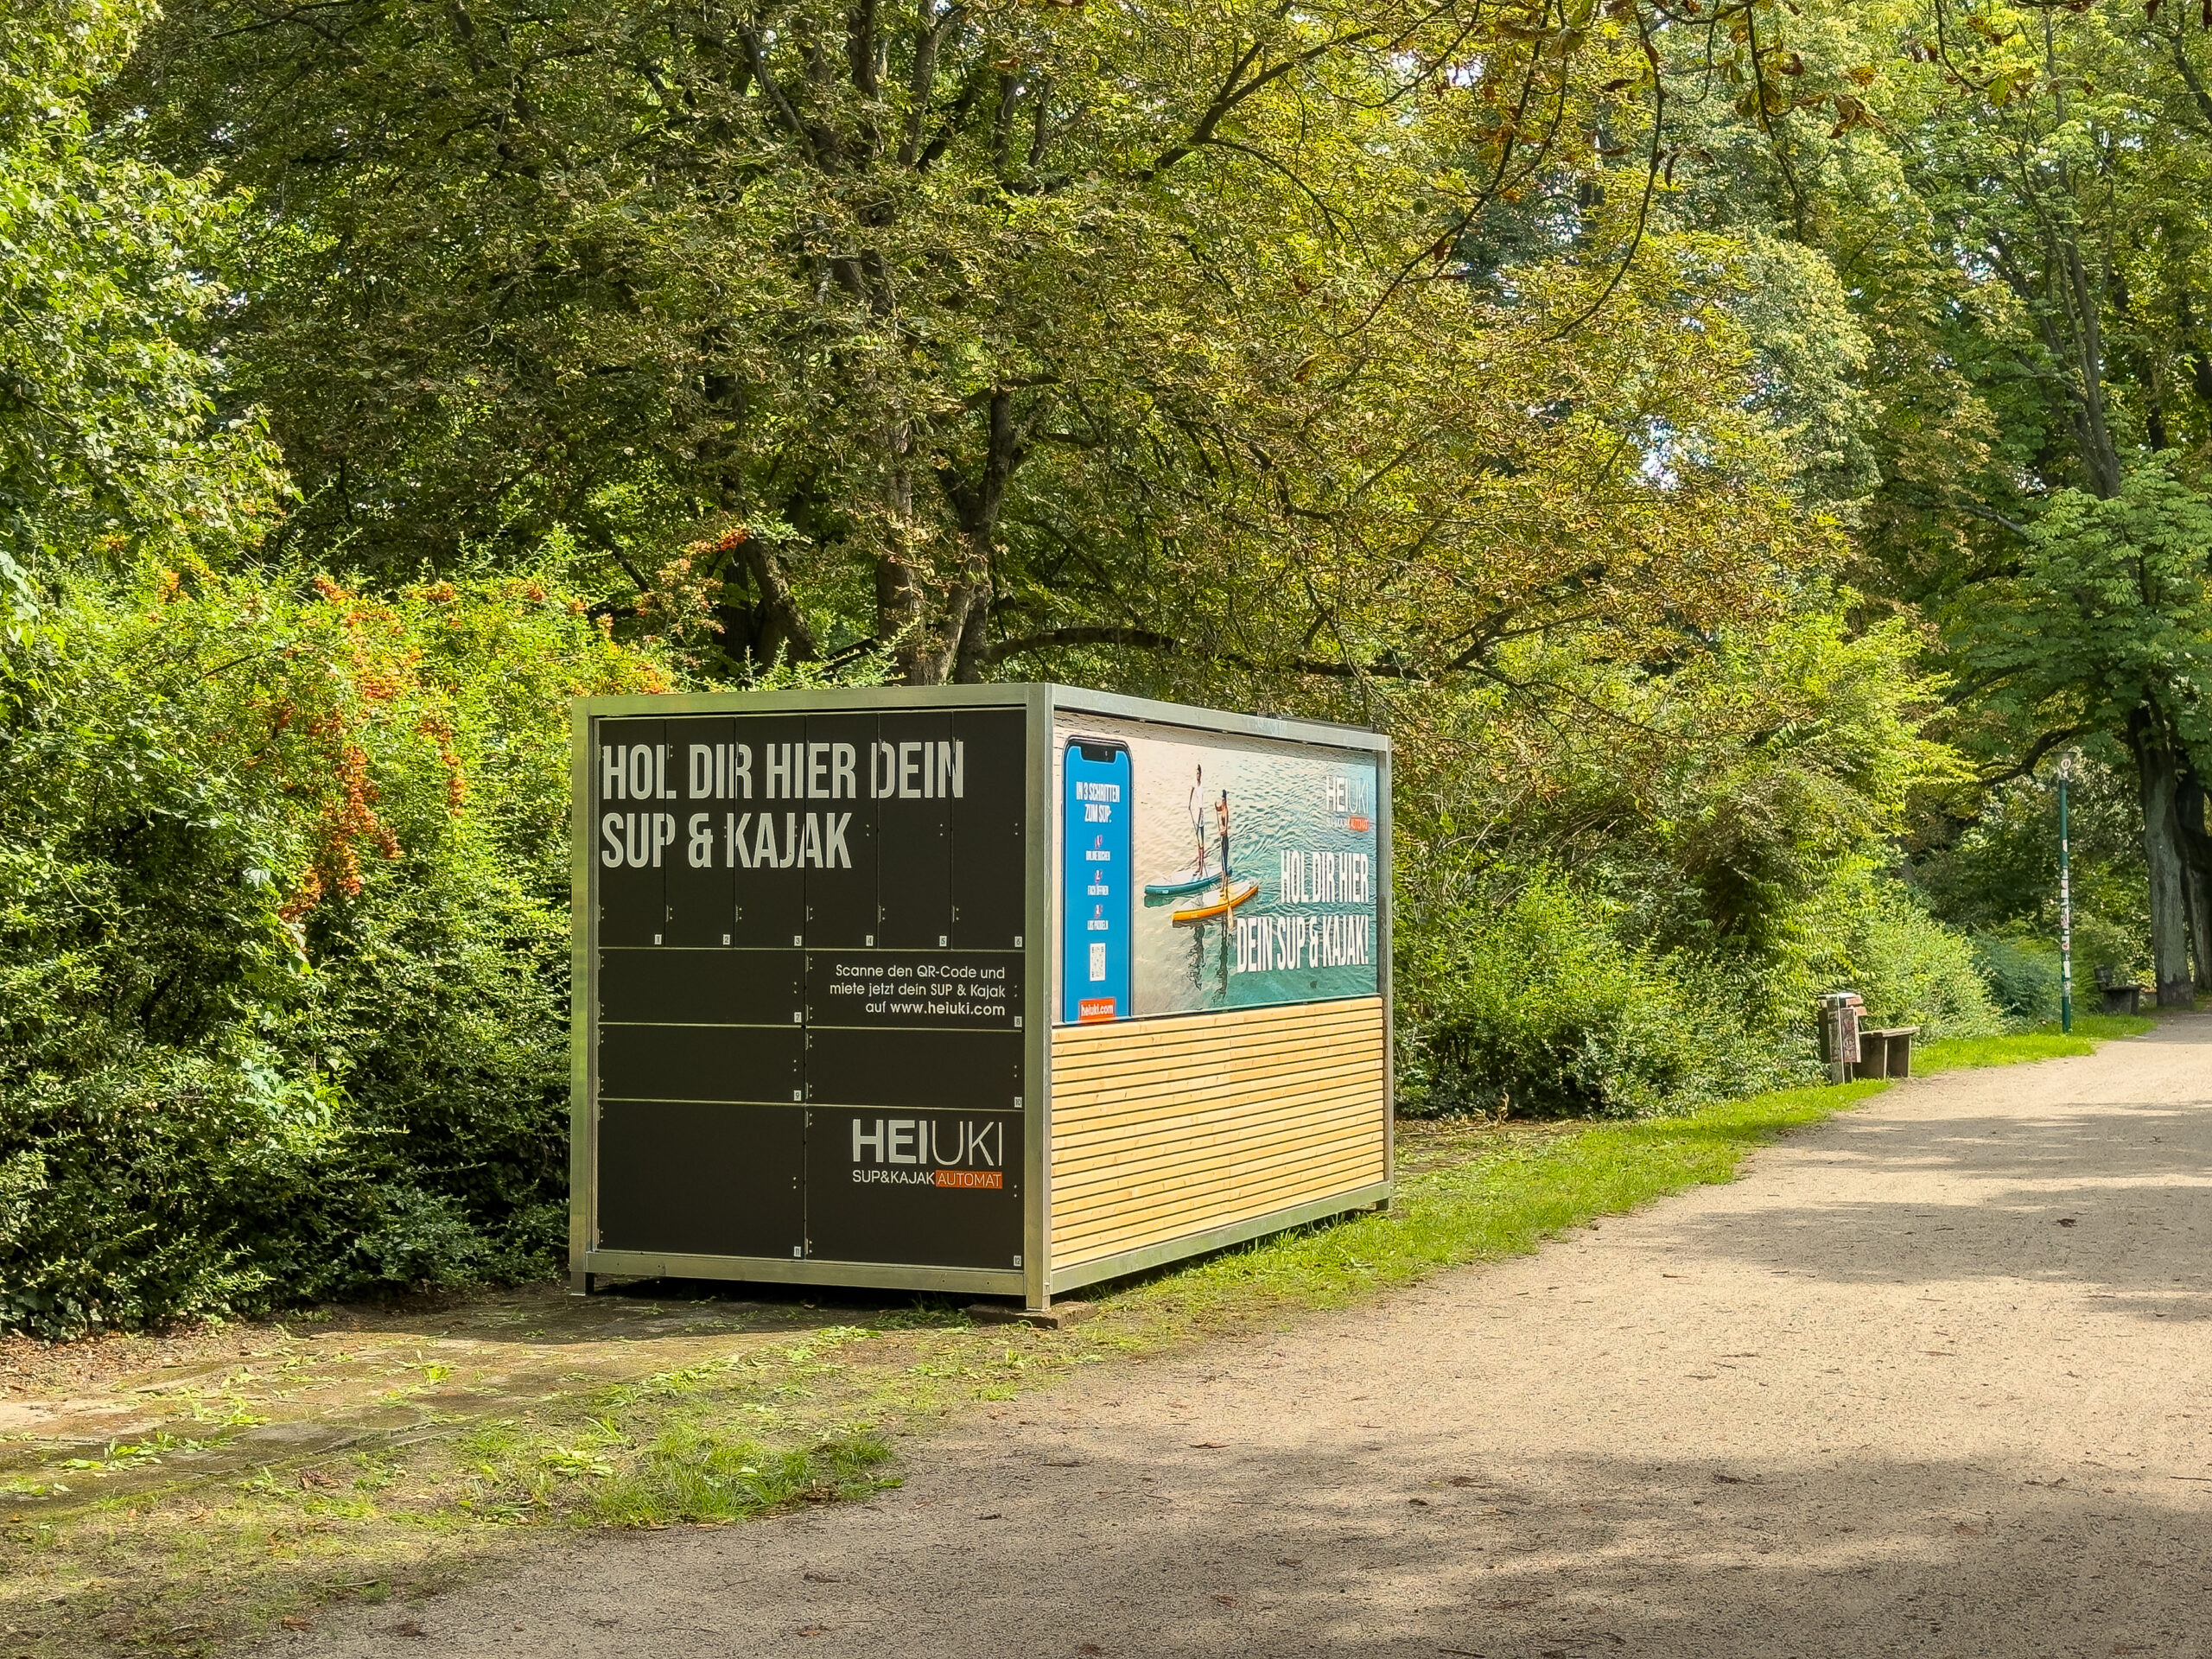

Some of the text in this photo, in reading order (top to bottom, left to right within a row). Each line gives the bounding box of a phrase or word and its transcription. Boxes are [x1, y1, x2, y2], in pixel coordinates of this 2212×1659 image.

[603, 741, 963, 799] HOL DIR HIER DEIN
[1084, 782, 1089, 801] 3
[1084, 804, 1098, 823] ZUM
[601, 812, 853, 868] SUP & KAJAK
[1280, 849, 1370, 905] HOL DIR HIER
[1236, 914, 1370, 973] DEIN SUP & KAJAK!
[836, 963, 1006, 980] Scanne den QR-Code und
[830, 982, 1006, 1001] miete jetzt dein SUP & Kajak
[865, 1001, 1006, 1016] auf www.heiuki.com
[1080, 1003, 1114, 1017] heiuki.com
[852, 1118, 1002, 1166] HEIUKI
[852, 1169, 1001, 1188] SUP&KAJAK AUTOMAT
